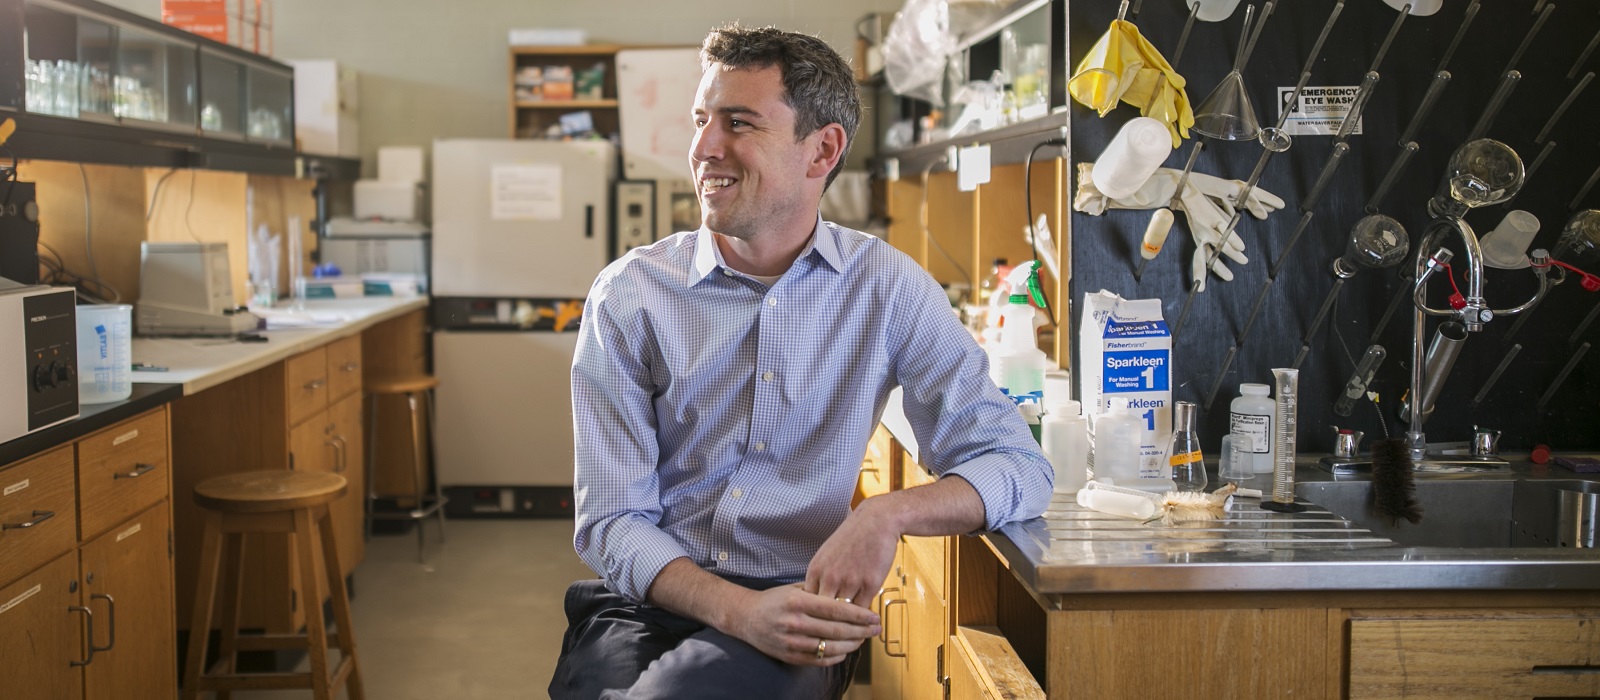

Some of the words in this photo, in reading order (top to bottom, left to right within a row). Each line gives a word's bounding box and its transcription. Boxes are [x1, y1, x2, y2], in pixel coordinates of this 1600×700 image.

[1301, 88, 1357, 96] EMERGENCY
[1326, 96, 1354, 104] WASH
[1107, 356, 1163, 369] Sparkleen
[1141, 366, 1154, 389] 1
[1107, 399, 1164, 408] Srkleen
[1142, 409, 1155, 431] 1
